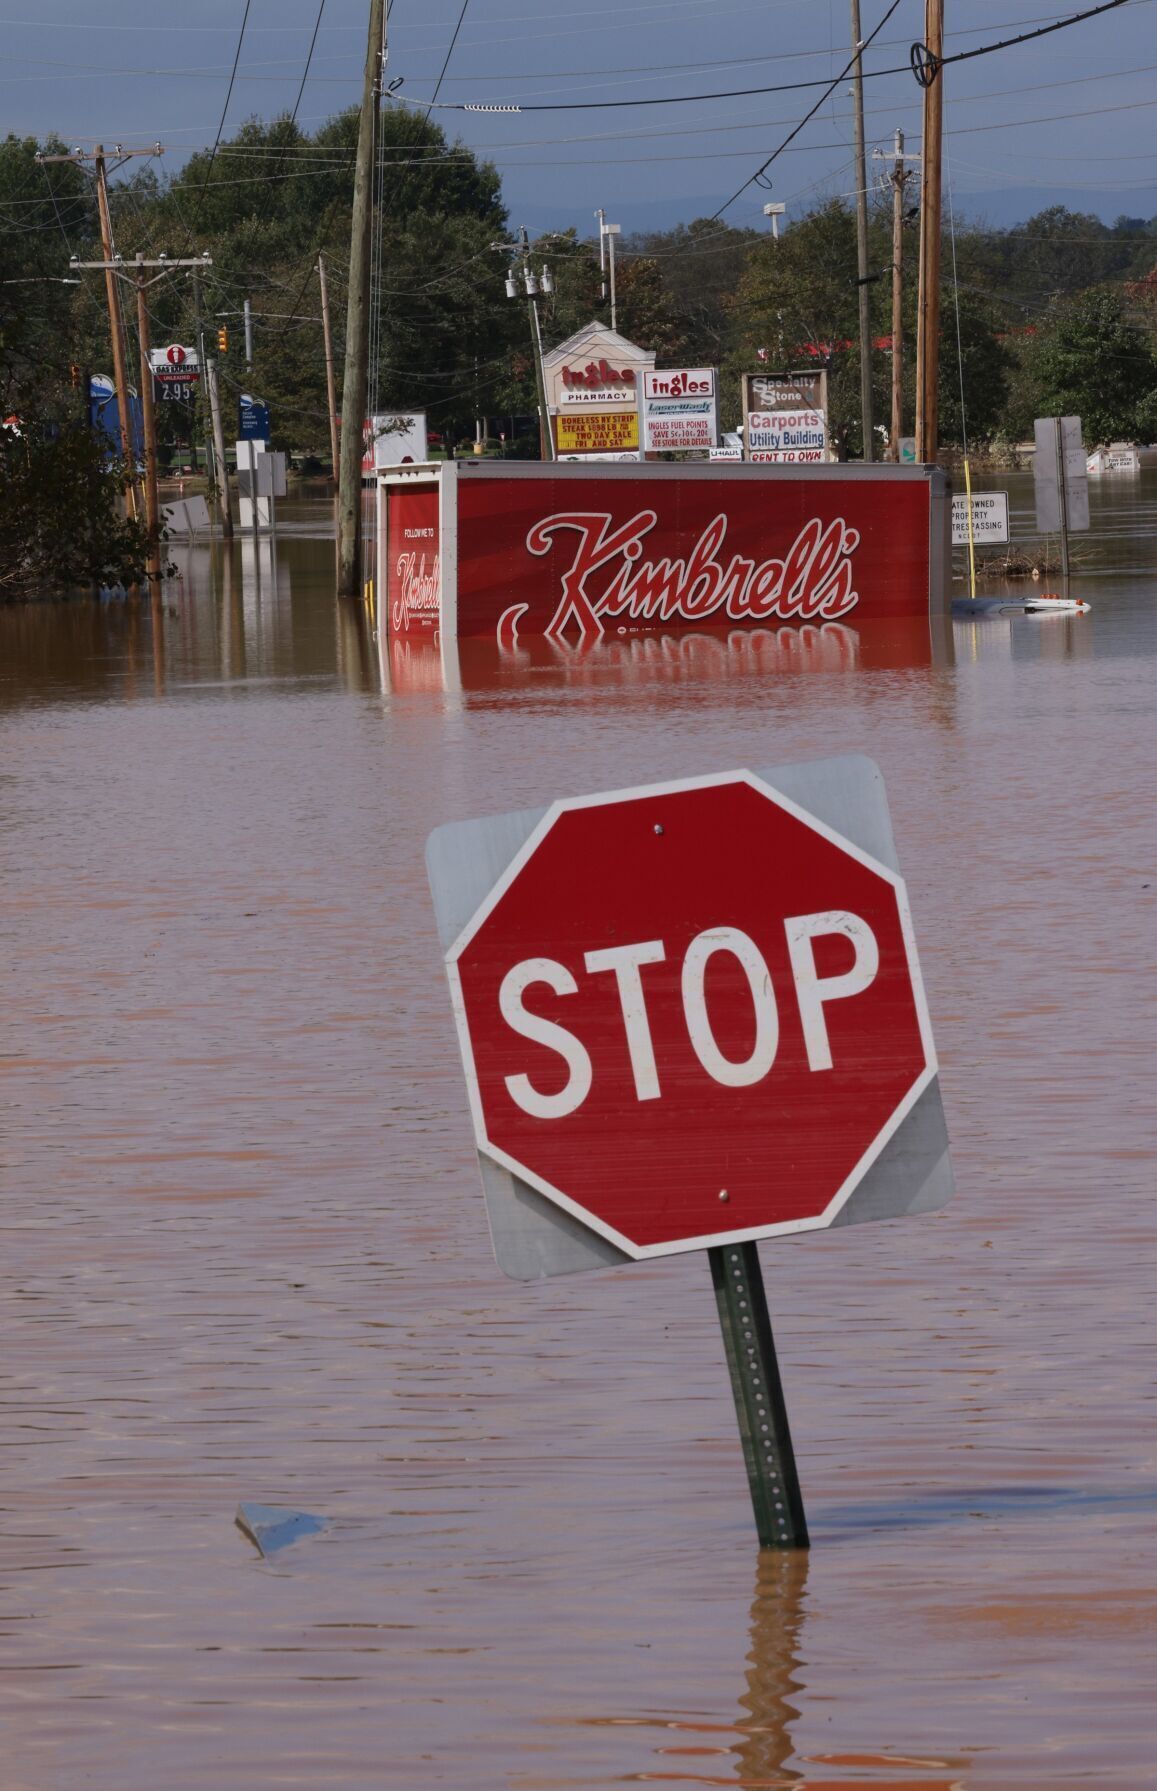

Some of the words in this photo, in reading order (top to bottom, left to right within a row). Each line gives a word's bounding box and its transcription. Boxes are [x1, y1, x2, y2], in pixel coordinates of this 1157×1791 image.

[561, 358, 635, 389] ingles
[652, 373, 709, 396] ingles
[751, 377, 816, 392] Specialty
[162, 383, 190, 400] 2.95
[568, 393, 628, 401] PHARMACY
[760, 390, 802, 406] Stone
[561, 416, 600, 424] BONELESS
[612, 414, 635, 423] STRIP
[750, 412, 819, 431] Carports
[562, 425, 586, 433] STEAK
[648, 421, 669, 430] INGLES
[670, 421, 685, 429] FUEL
[686, 420, 708, 429] POINTS
[576, 432, 592, 440] TWO
[594, 431, 610, 439] DAY
[612, 430, 632, 438] SALE
[653, 430, 669, 439] SAVE
[750, 432, 780, 448] Utility
[783, 430, 824, 448] Building
[592, 439, 608, 447] AND
[609, 439, 624, 447] SAT
[652, 439, 662, 447] SEE
[662, 439, 679, 447] STORE
[679, 438, 691, 446] FOR
[691, 437, 712, 446] DETAILS
[752, 452, 779, 462] RENT
[782, 452, 795, 461] TO
[798, 451, 822, 461] OWN
[952, 501, 964, 509] ATE
[952, 521, 1002, 531] TRESPASSING
[404, 528, 421, 538] FOLLOW
[428, 527, 434, 537] TO
[496, 510, 860, 636] Kimbrell's
[499, 910, 880, 1119] STOP
